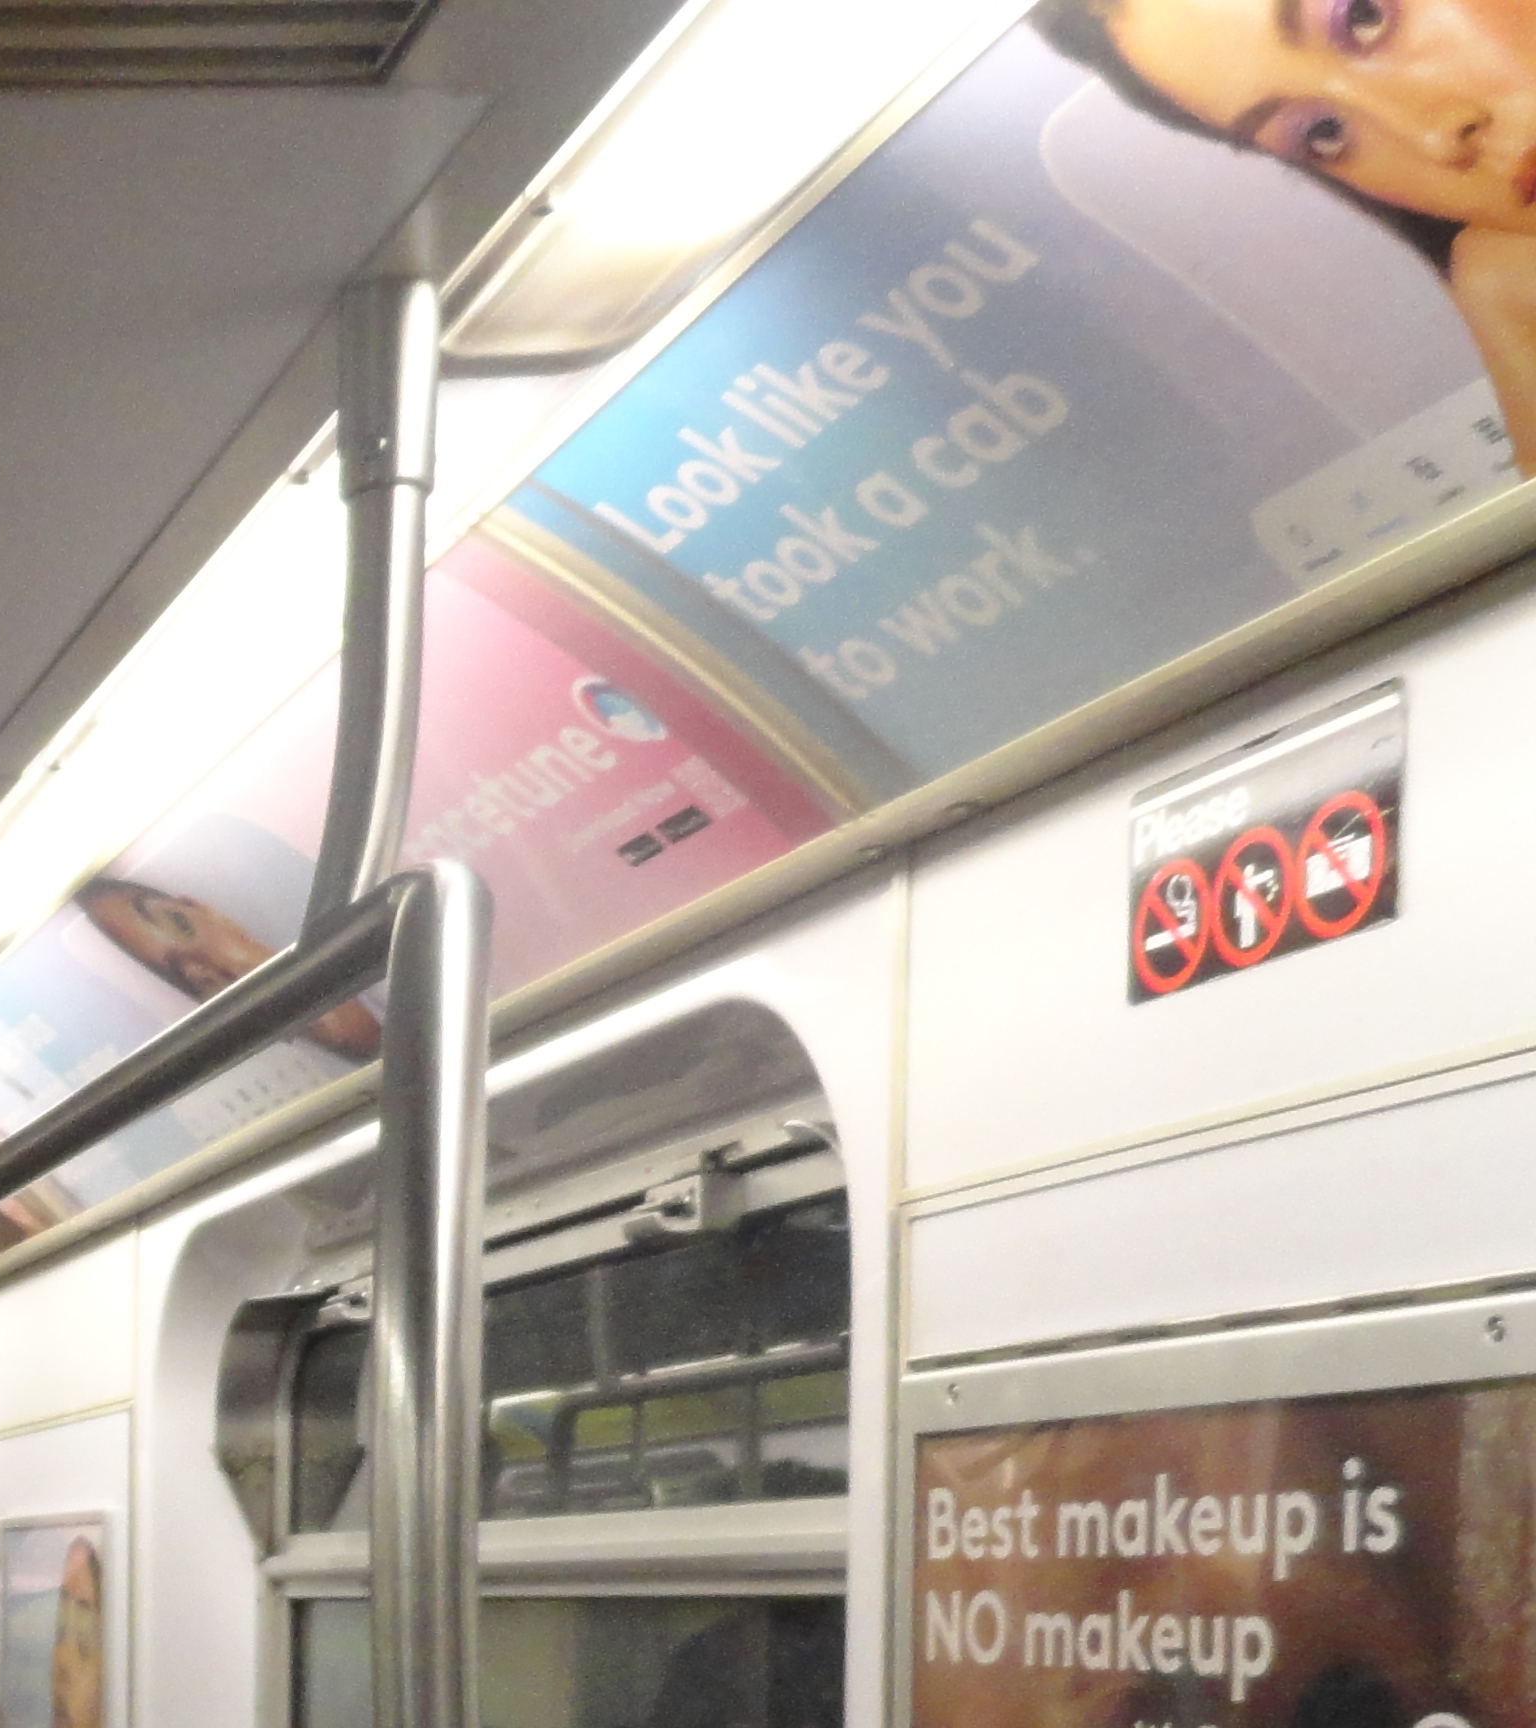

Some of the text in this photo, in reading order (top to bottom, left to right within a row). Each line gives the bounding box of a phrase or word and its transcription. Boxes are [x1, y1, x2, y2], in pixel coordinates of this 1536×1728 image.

[594, 219, 1039, 554] Look like you
[702, 369, 1068, 620] took a cab
[798, 521, 1097, 698] to work.
[404, 726, 618, 862] acetune
[1132, 786, 1250, 868] Please
[926, 1456, 1406, 1581] Best makeup is
[926, 1590, 1274, 1702] NO makeup
